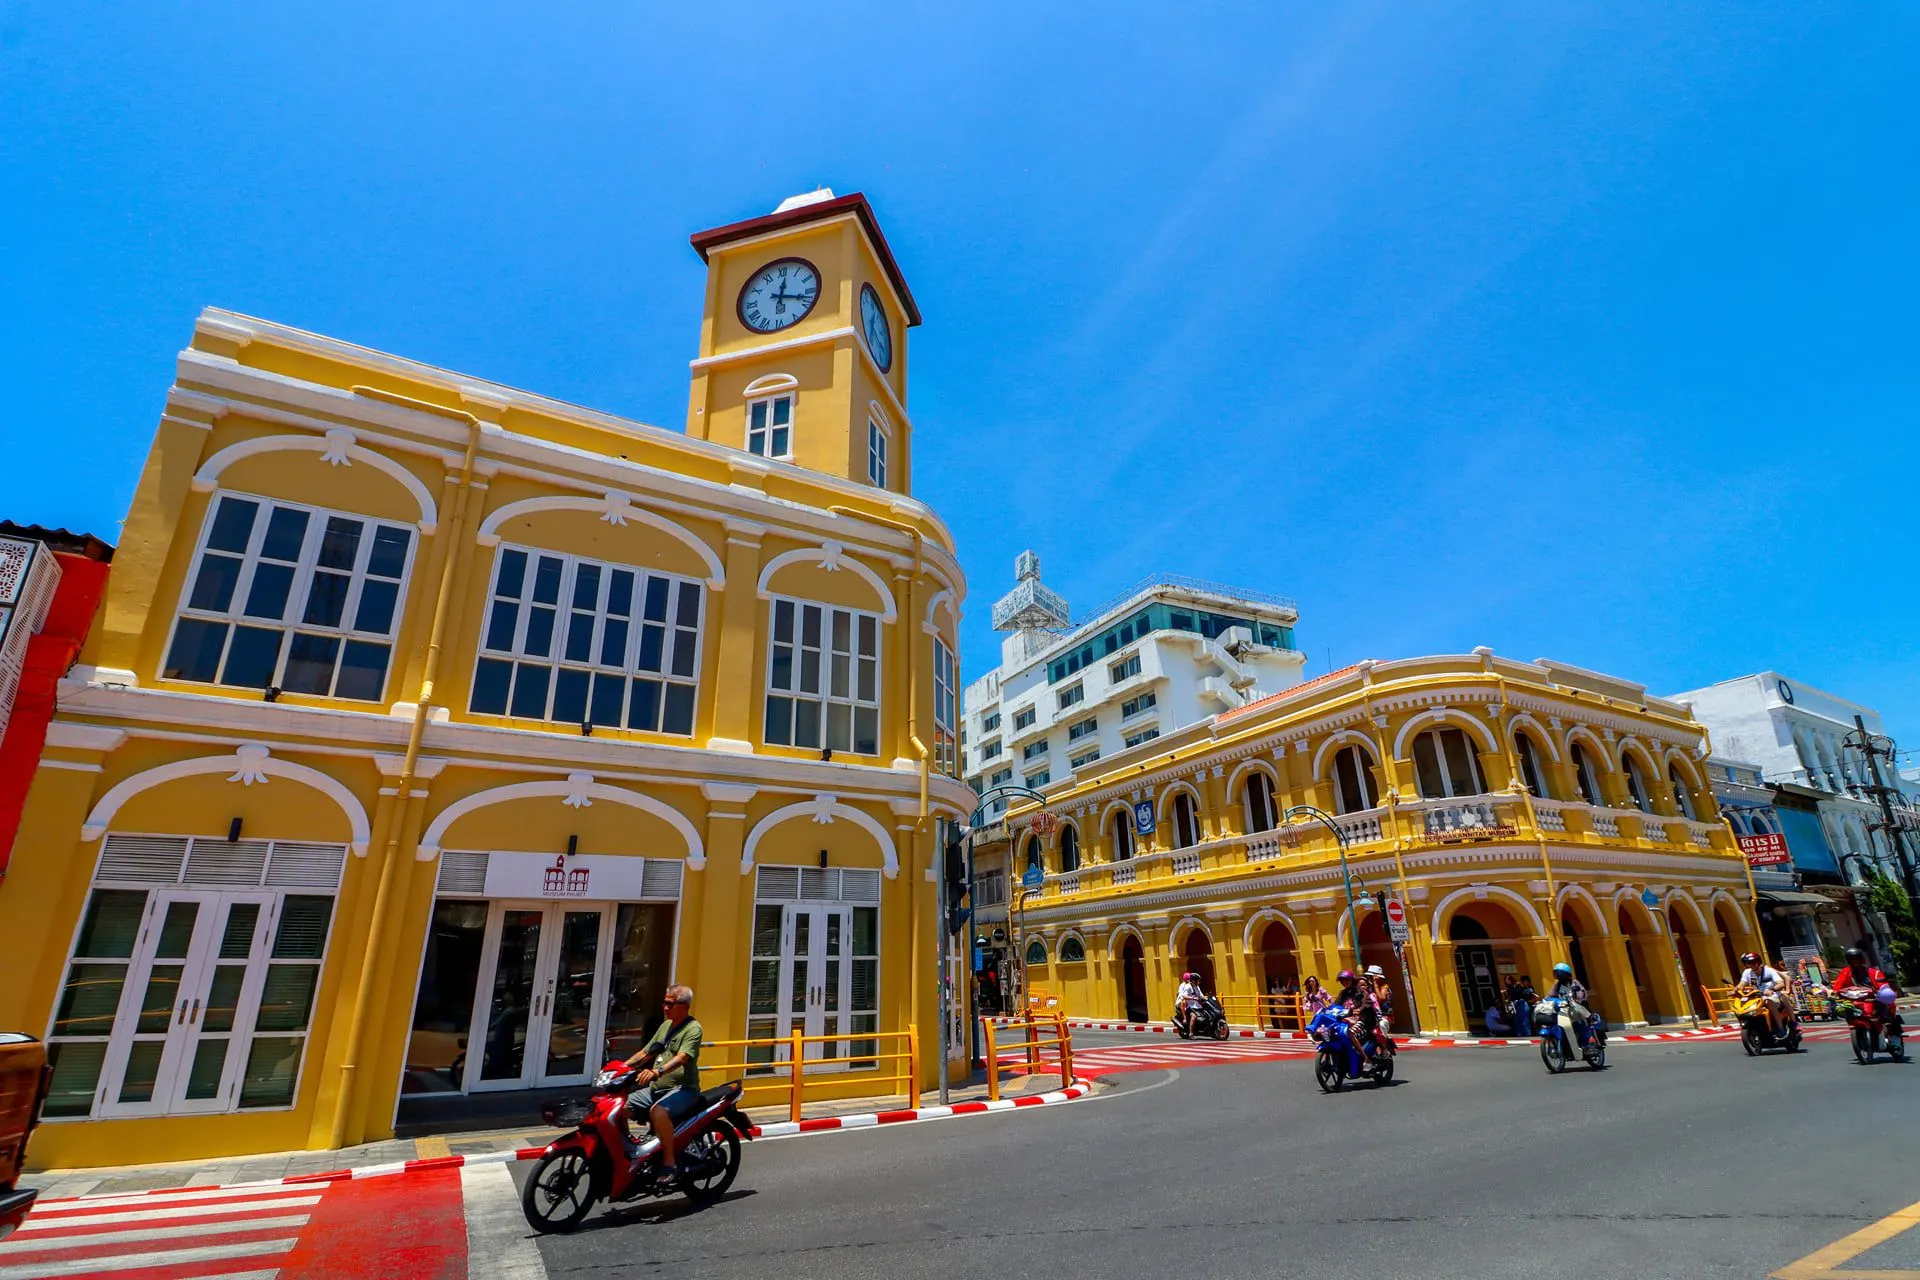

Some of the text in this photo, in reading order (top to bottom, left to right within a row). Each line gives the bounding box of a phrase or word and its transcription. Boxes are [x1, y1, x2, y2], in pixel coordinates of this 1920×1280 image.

[778, 267, 787, 278] XII
[763, 274, 773, 285] XI
[747, 301, 757, 309] IX
[749, 310, 761, 324] VIII
[760, 318, 770, 330] VII
[776, 320, 783, 328] VI
